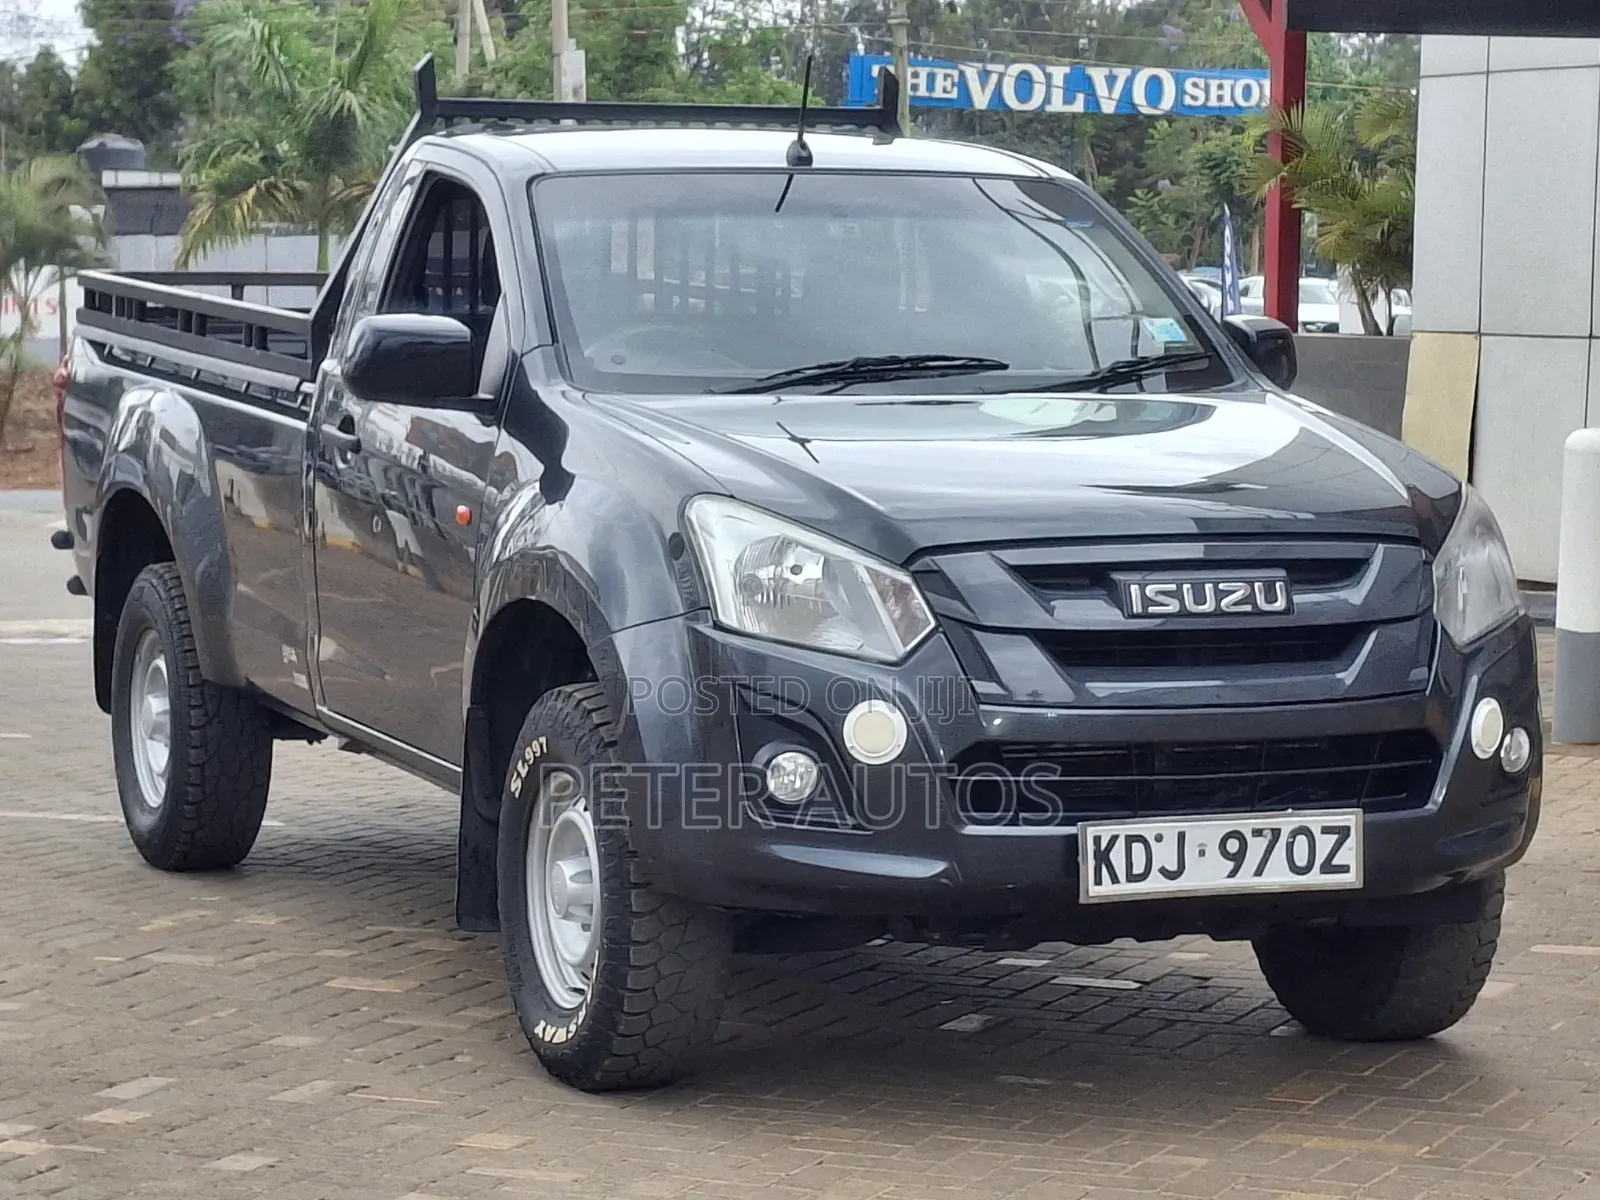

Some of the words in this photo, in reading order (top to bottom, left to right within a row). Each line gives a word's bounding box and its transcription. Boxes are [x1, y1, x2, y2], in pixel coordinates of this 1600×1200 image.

[958, 63, 1176, 114] VOLVO
[1130, 581, 1287, 614] ISUZU
[1093, 830, 1187, 886] KDJ
[1218, 825, 1352, 879] 970Z
